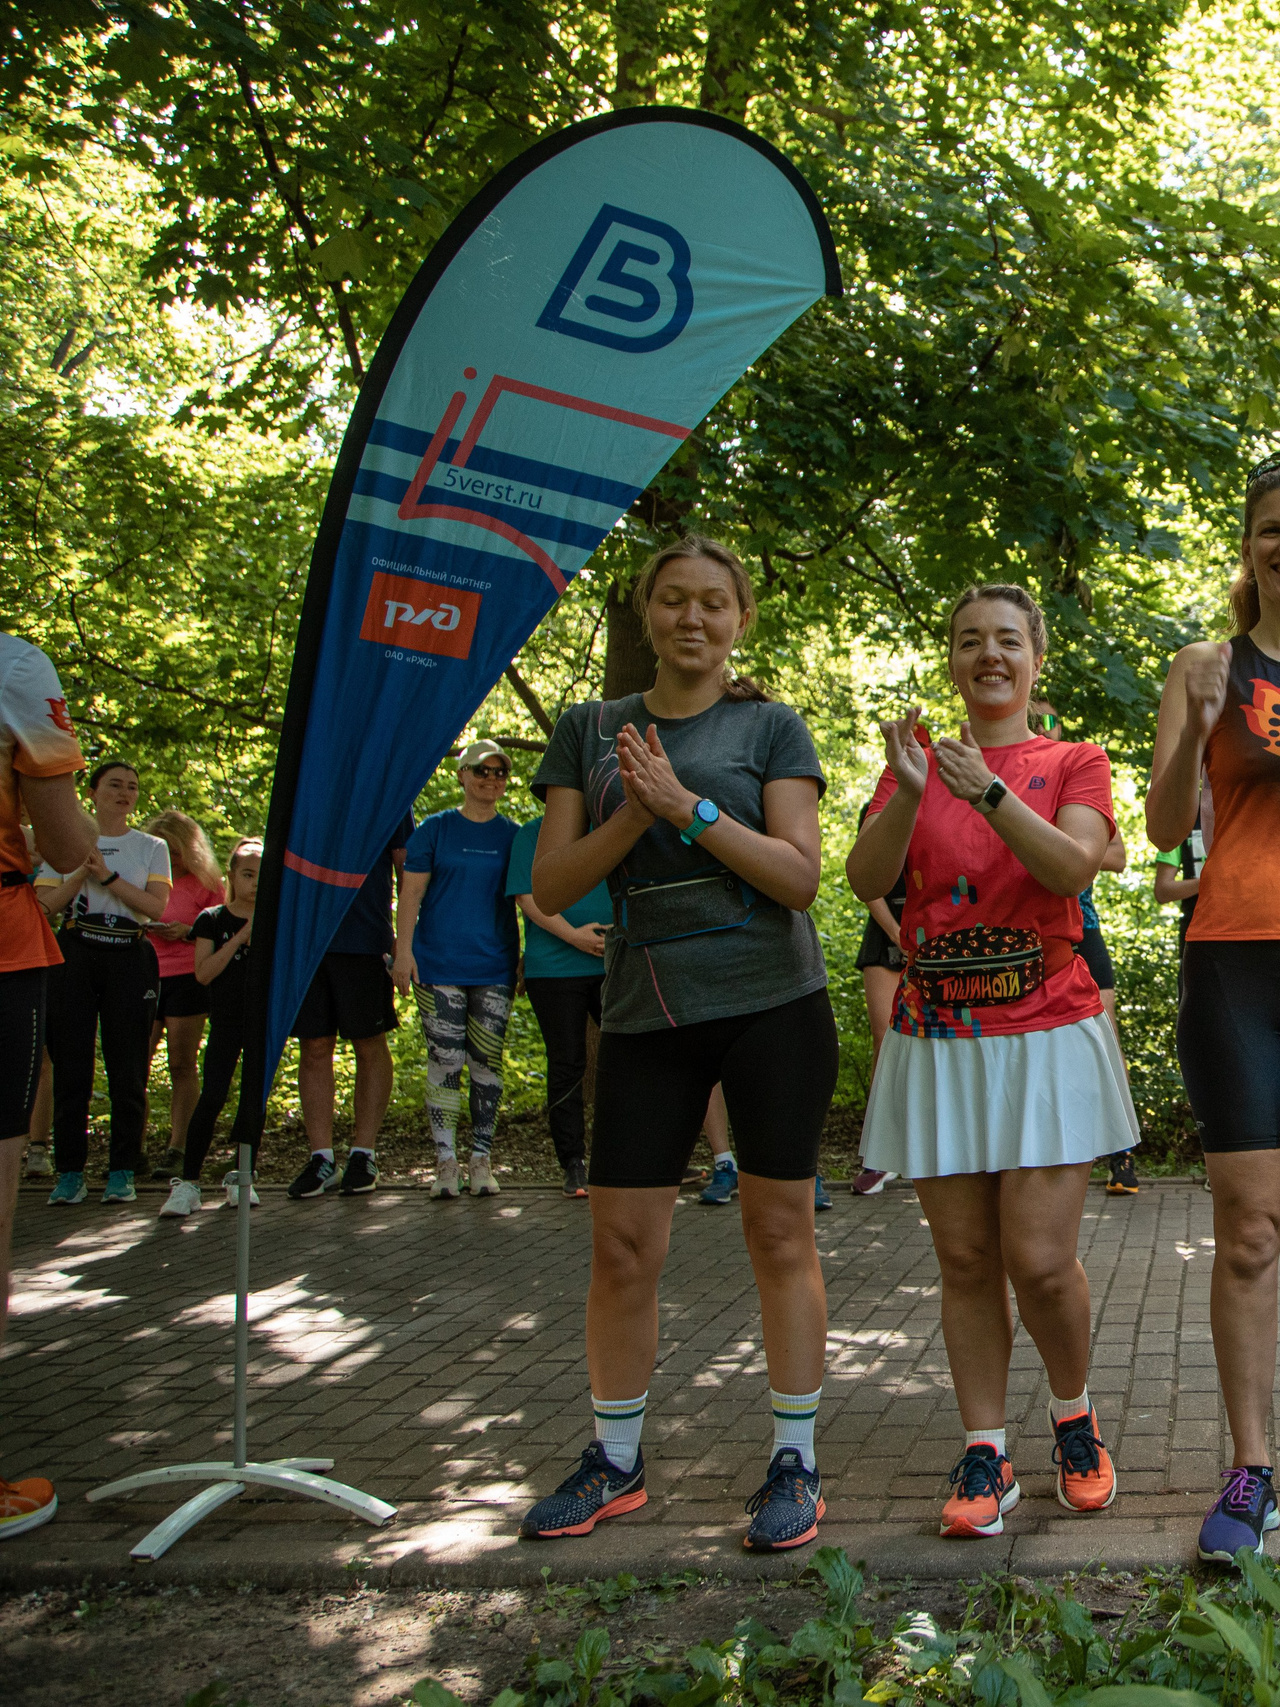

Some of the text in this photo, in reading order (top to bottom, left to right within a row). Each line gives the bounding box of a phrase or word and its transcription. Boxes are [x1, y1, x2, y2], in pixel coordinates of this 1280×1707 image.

[443, 467, 542, 509] 5verst.ru
[371, 556, 492, 591] ОФИЦИАЛЬНЫЙ ПАРТНЕР
[384, 650, 438, 669] ОАО «РЖД»
[937, 971, 1020, 1001] ТУШИНОГИ
